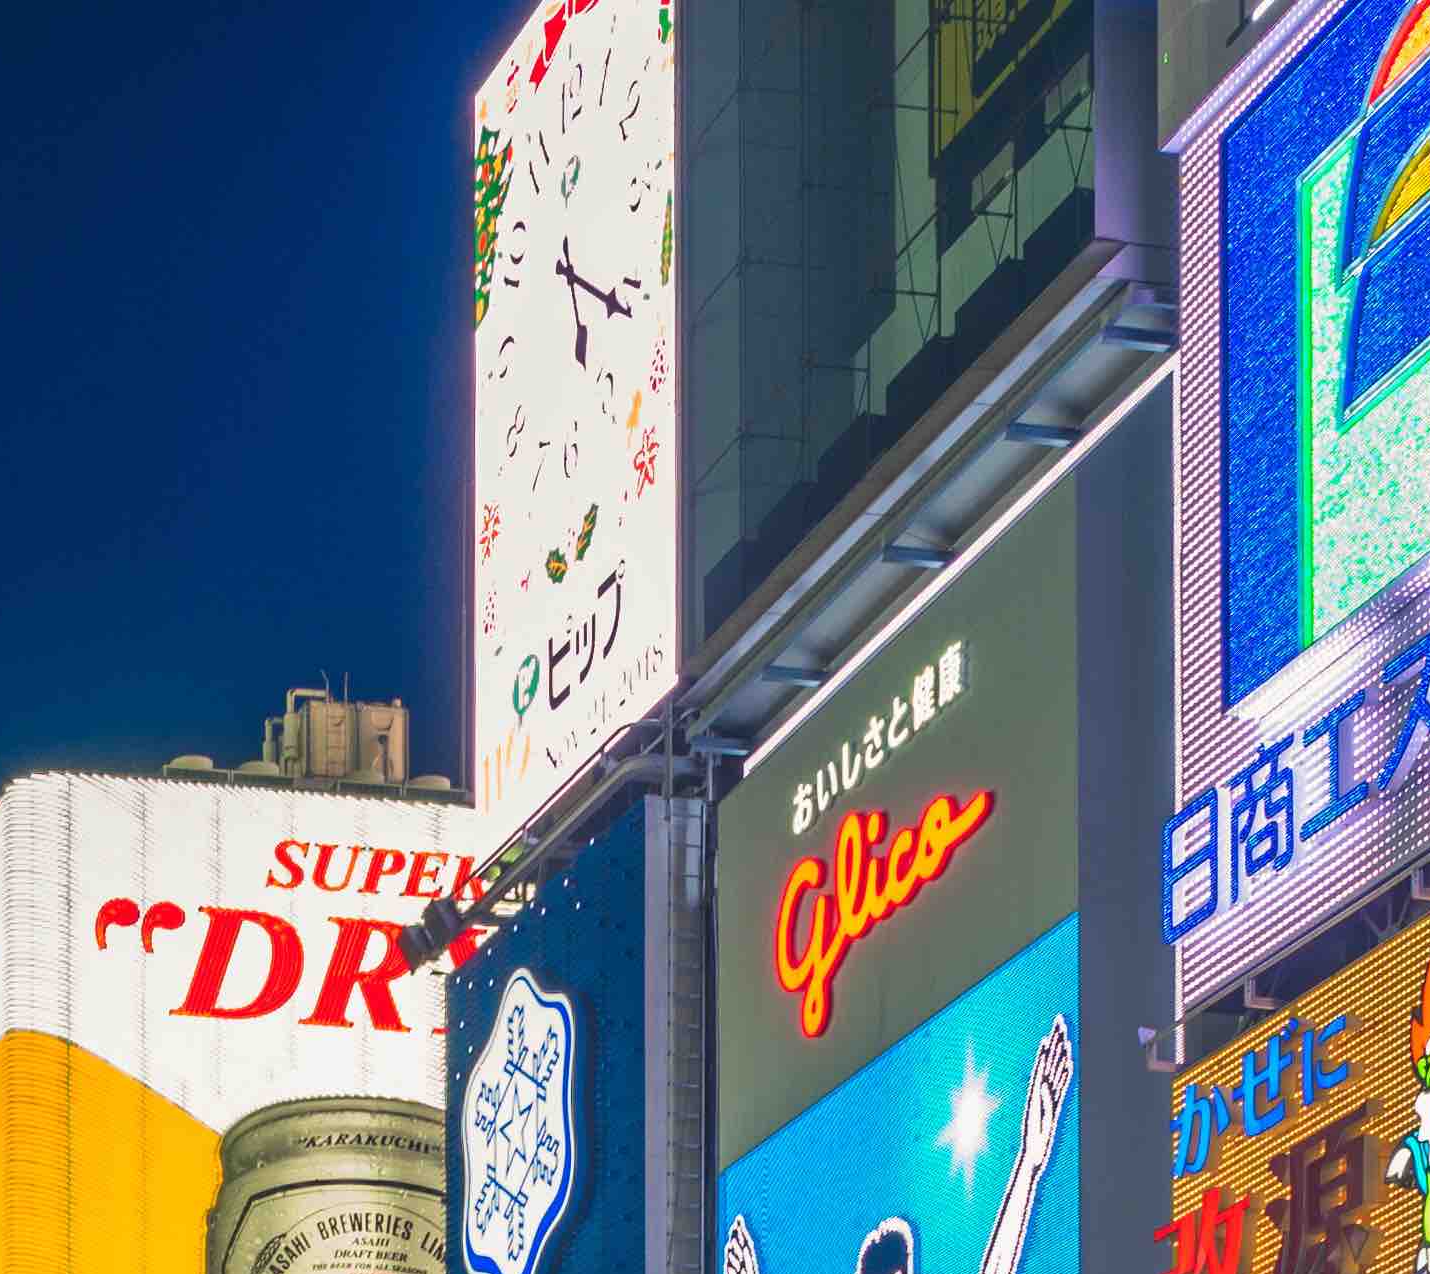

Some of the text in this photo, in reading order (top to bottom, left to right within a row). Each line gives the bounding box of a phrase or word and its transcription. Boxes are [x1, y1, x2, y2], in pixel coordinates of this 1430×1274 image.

[546, 558, 626, 712] ピップ
[792, 640, 964, 835] おいしさと健康
[775, 788, 996, 1039] Glico
[1170, 1013, 1348, 1178] かぜに
[316, 1212, 414, 1242] BREWERIES
[334, 1249, 409, 1263] DRAFT BEER
[351, 1237, 390, 1248] ASAHI
